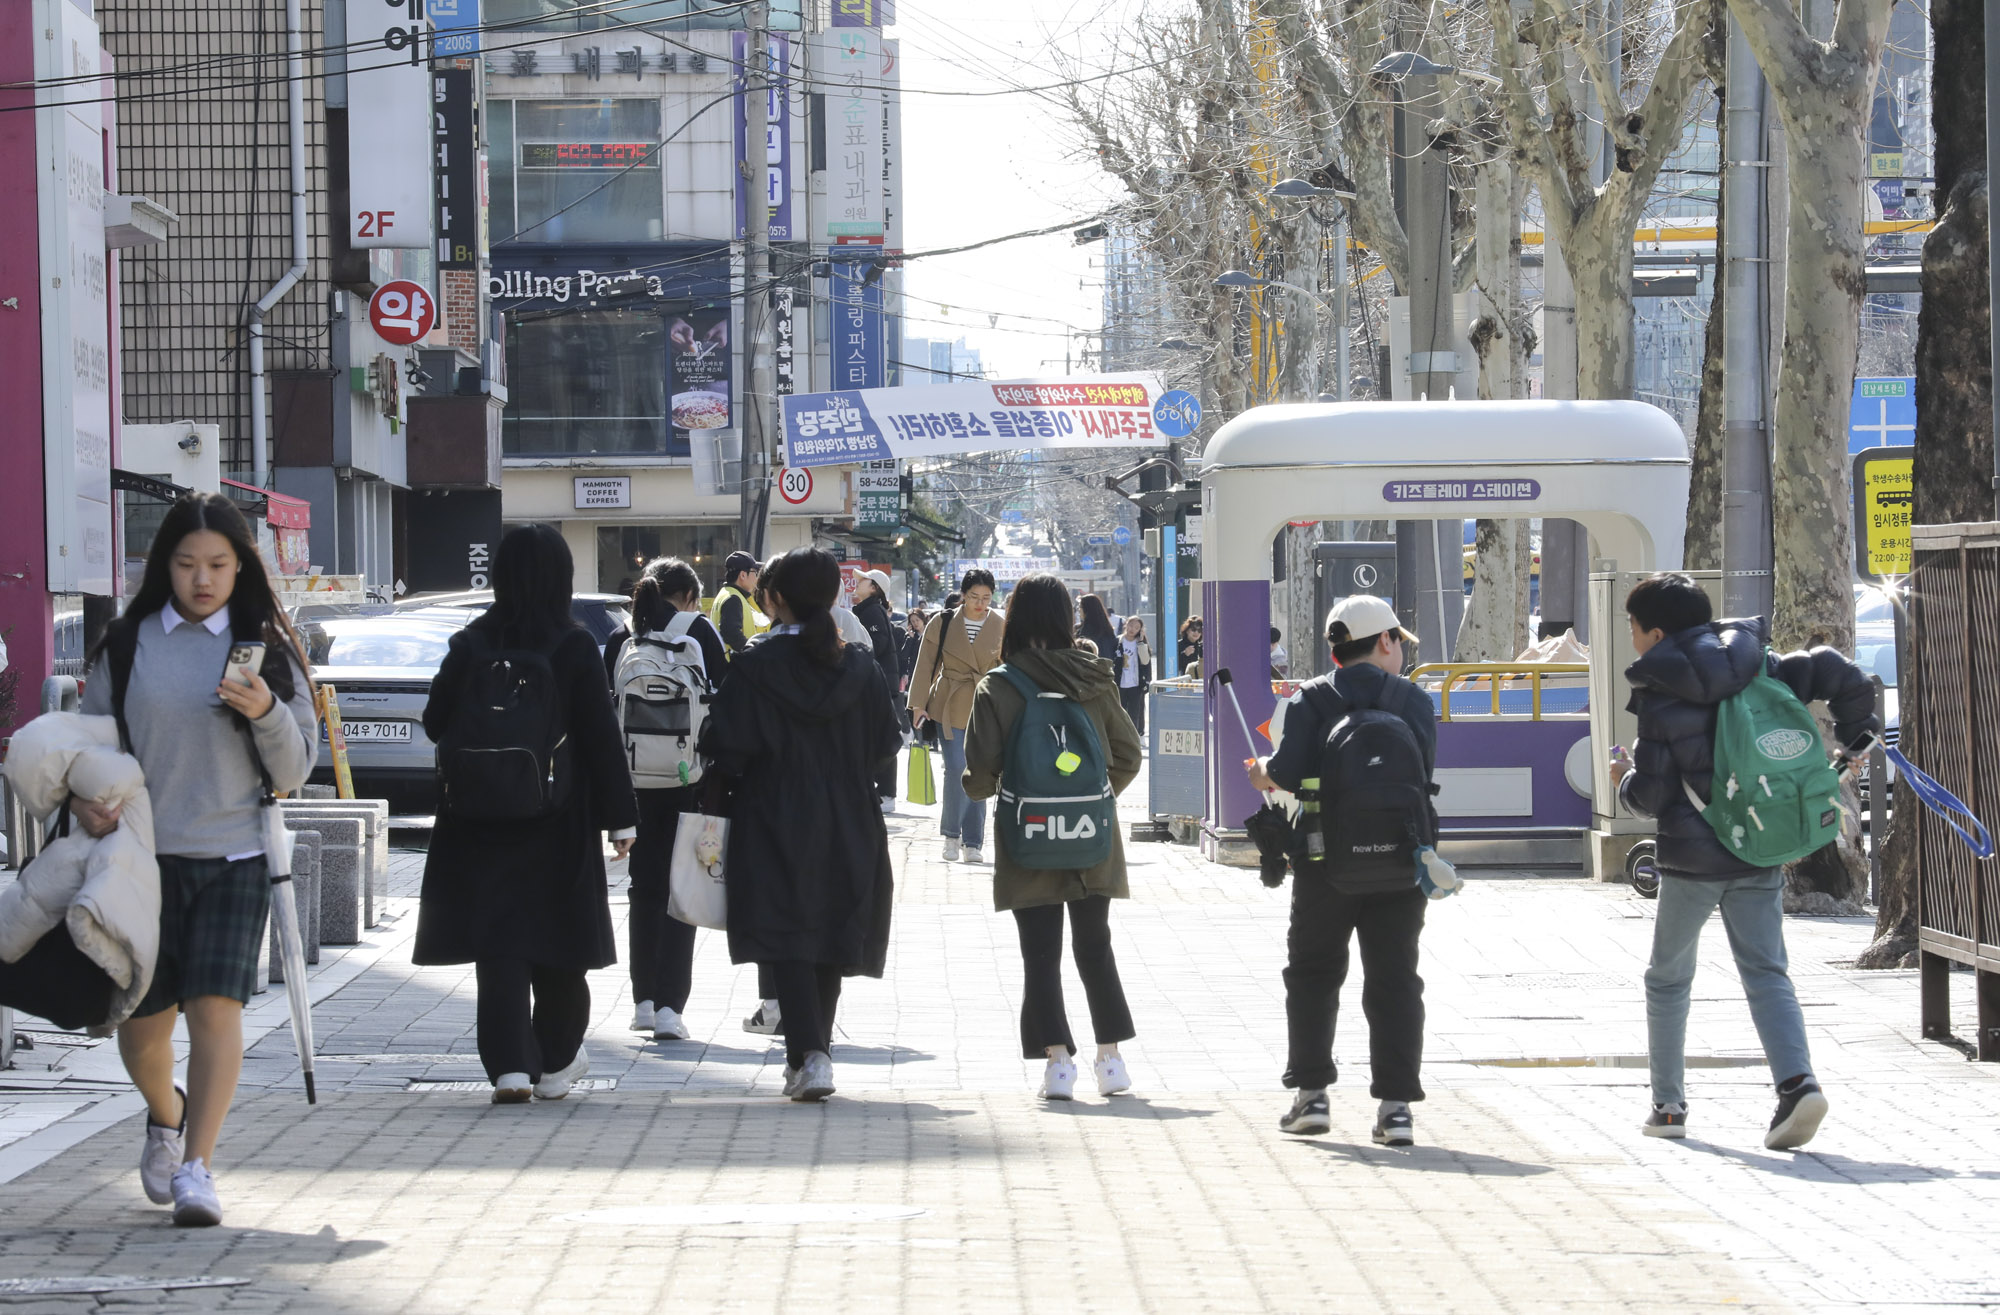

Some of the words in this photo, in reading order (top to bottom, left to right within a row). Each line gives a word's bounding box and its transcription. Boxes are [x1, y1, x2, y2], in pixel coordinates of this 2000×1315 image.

[844, 207, 867, 221] 의원
[357, 211, 395, 237] 2F
[455, 245, 473, 262] B1
[489, 271, 571, 303] olling
[378, 291, 426, 337] 약
[777, 383, 793, 392] 복사
[786, 473, 806, 492] 30
[859, 477, 899, 487] 58-4252
[1393, 483, 1467, 499] 키즈플레이
[1472, 482, 1532, 498] 스테이션
[878, 496, 899, 509] 환영
[858, 510, 898, 523] 포장가능
[1873, 512, 1912, 528] 임시정류
[343, 723, 370, 737] 04우
[374, 724, 407, 737] 7014
[1025, 814, 1096, 840] FILA
[1352, 845, 1372, 853] new
